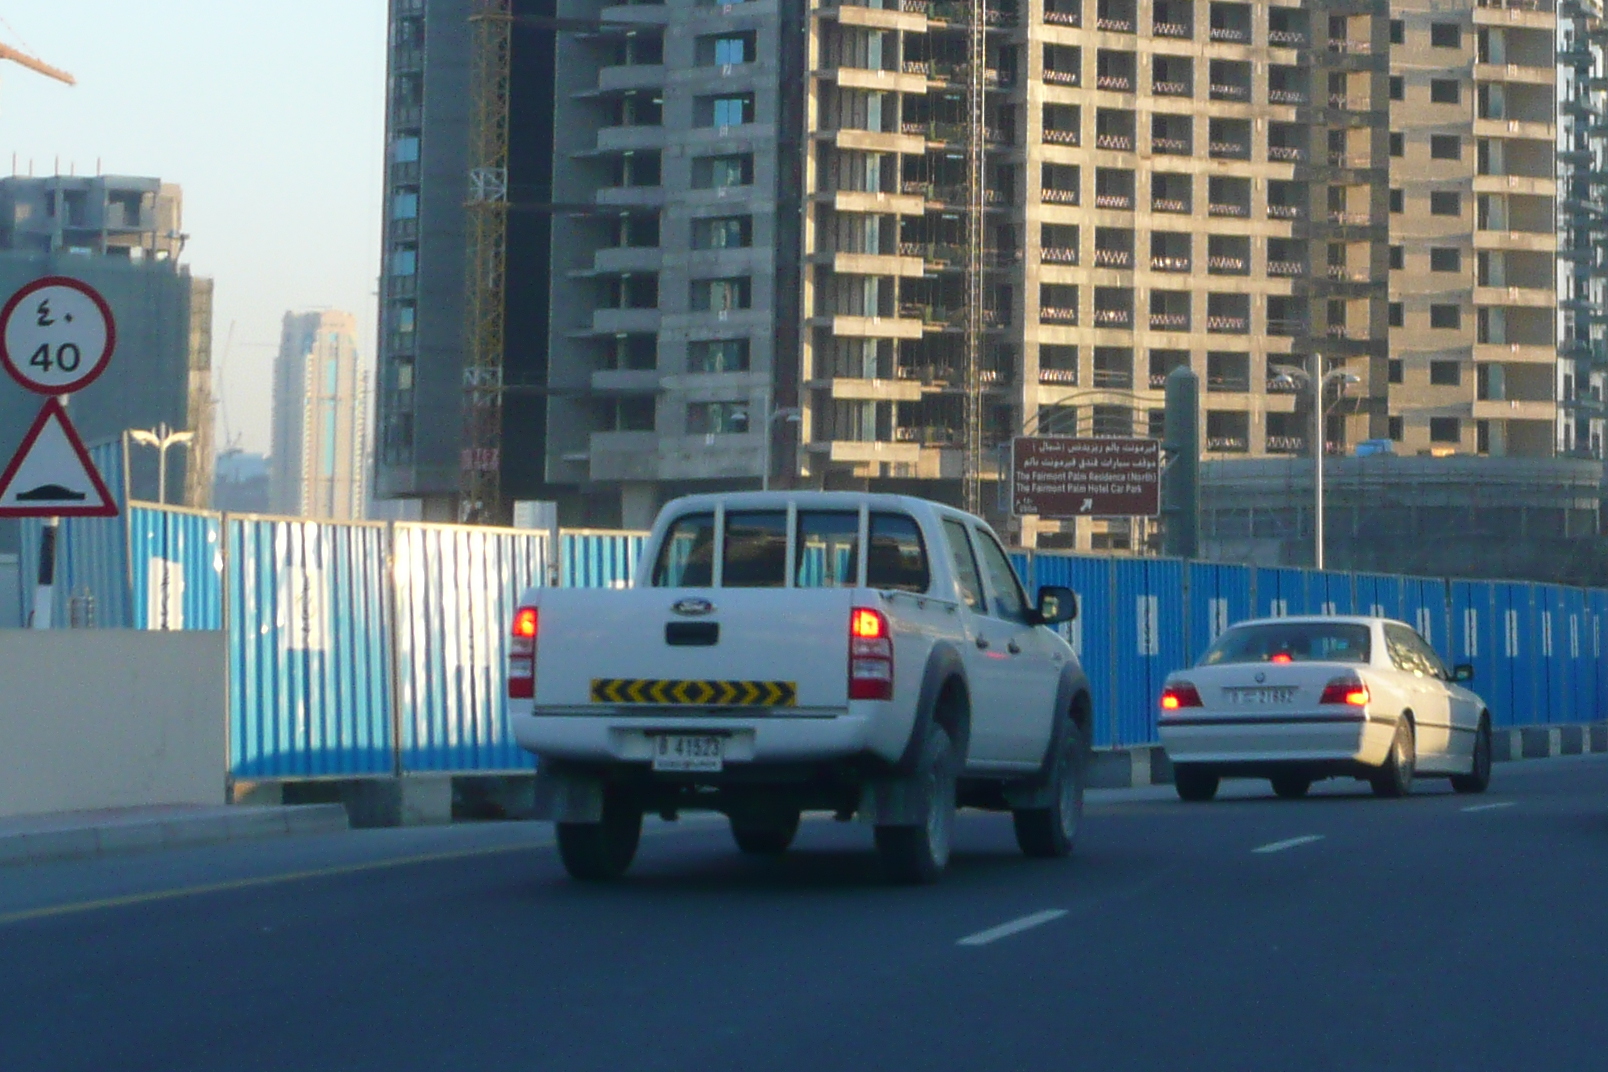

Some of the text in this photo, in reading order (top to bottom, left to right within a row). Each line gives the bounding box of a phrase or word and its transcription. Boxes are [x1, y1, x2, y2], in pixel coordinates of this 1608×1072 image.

[37, 298, 74, 327] ٤٠
[30, 342, 80, 372] 40
[1016, 471, 1031, 481] The
[1032, 471, 1066, 481] Fairmont
[1067, 471, 1087, 481] Palm
[1089, 471, 1126, 482] Residence
[1016, 483, 1142, 494] The Fairmont Palm Hotel Car Park
